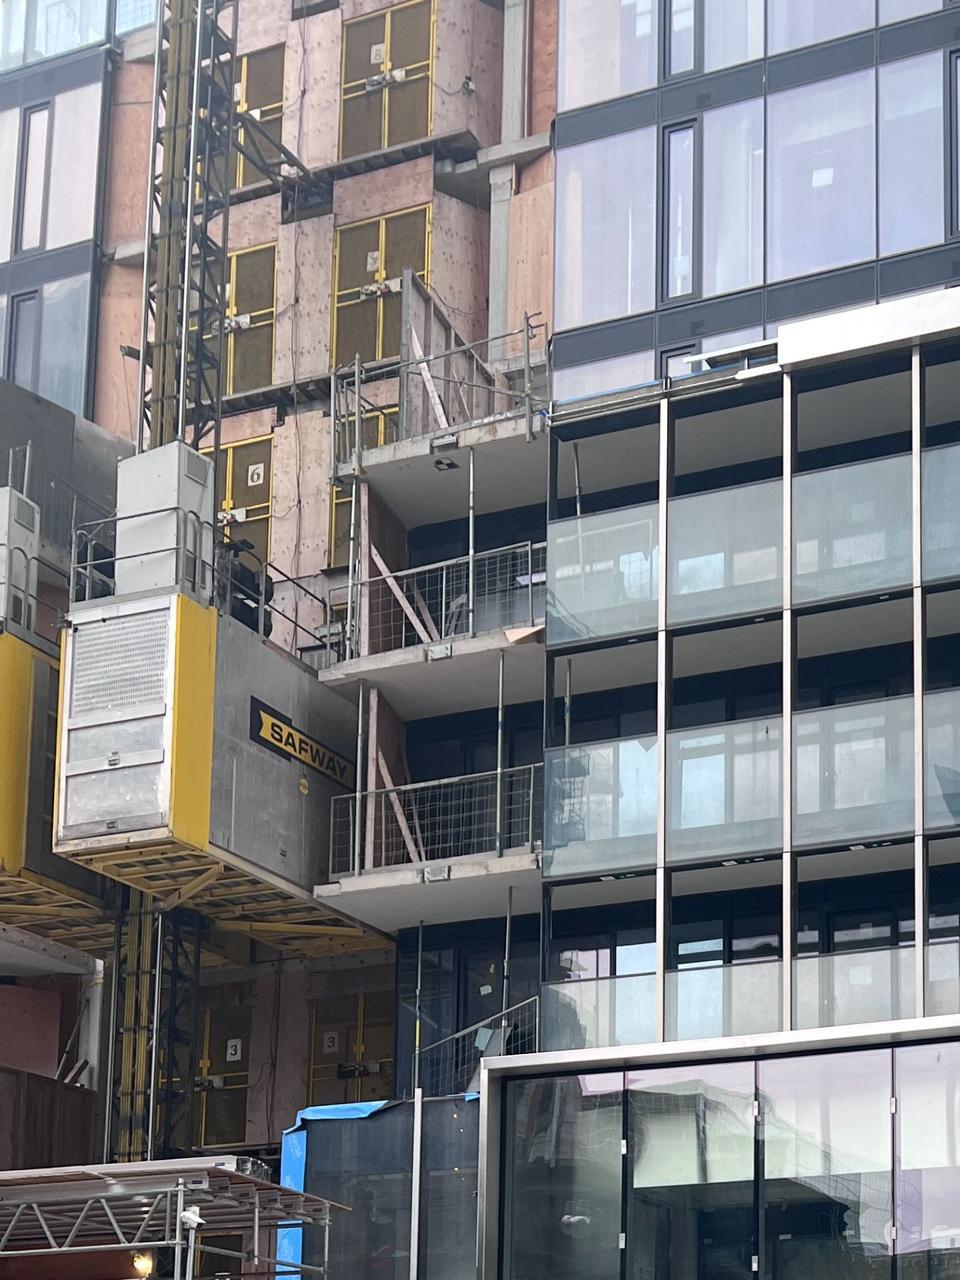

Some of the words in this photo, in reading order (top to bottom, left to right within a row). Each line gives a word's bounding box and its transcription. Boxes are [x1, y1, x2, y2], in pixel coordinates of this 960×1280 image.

[250, 466, 260, 483] 6
[271, 722, 348, 780] SAFWAY
[327, 1036, 335, 1048] 3
[230, 1044, 238, 1056] 3
